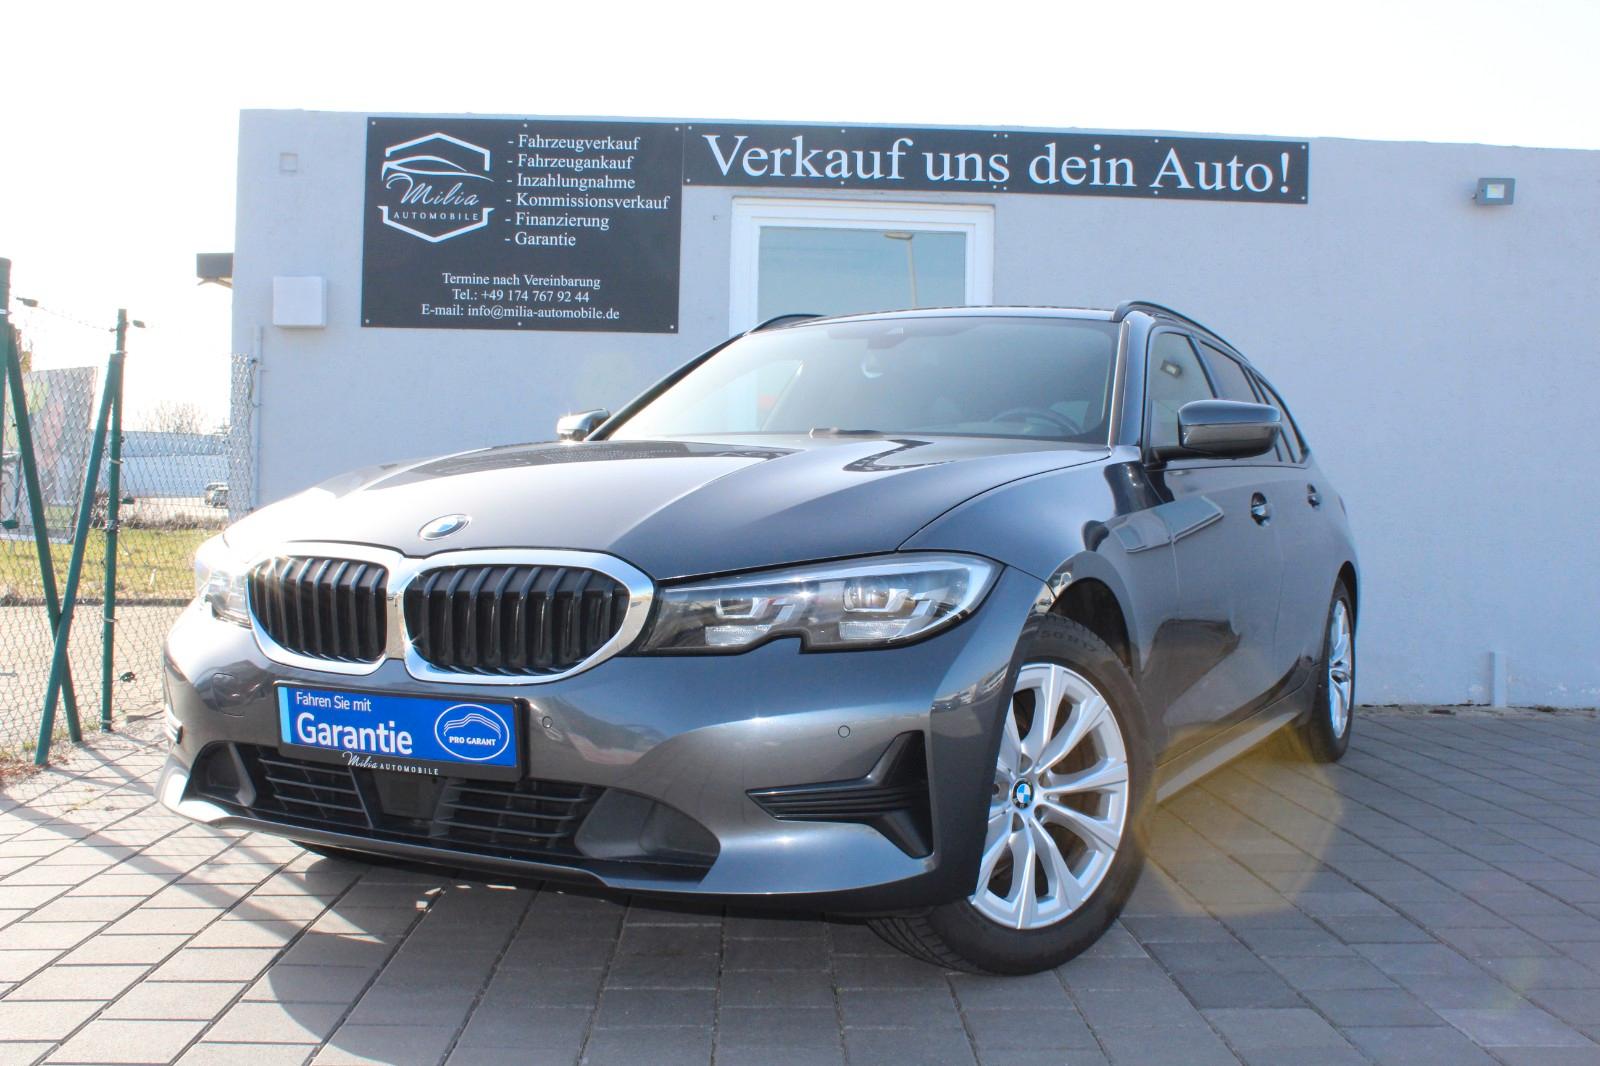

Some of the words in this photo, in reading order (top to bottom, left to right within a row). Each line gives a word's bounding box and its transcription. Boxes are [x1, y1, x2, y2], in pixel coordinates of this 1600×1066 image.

[518, 134, 641, 153] Fahrzeugverkauf
[517, 153, 634, 172] Fahrzeugankauf
[702, 134, 913, 181] Verkauf
[922, 149, 1010, 184] uns
[1029, 142, 1135, 188] dein
[1151, 147, 1290, 194] Auto!
[386, 173, 479, 206] Milia
[516, 173, 636, 192] Inzahlungnahme
[516, 192, 671, 210] Kommissionsverkauf
[393, 211, 479, 221] AUTOMOBILE
[515, 212, 610, 230] Finanzierung
[514, 231, 577, 248] Garantie
[442, 272, 490, 287] Termine
[493, 273, 520, 287] nach
[523, 274, 601, 290] Vereinbarung
[452, 288, 478, 301] Tel.:
[481, 290, 504, 302] +49
[508, 290, 529, 302] 174
[532, 291, 554, 303] 767
[557, 291, 572, 303] 92
[574, 291, 590, 303] 44
[421, 304, 464, 316] E-mail:
[467, 304, 620, 320] info@milia-automobile.de
[296, 692, 332, 709] Fahren
[333, 695, 351, 710] Sie
[353, 697, 372, 712] mit
[297, 712, 413, 755] Garantie
[449, 736, 465, 745] PRO
[466, 736, 496, 747] GARANT
[380, 763, 440, 776] AUTOMOBILE
